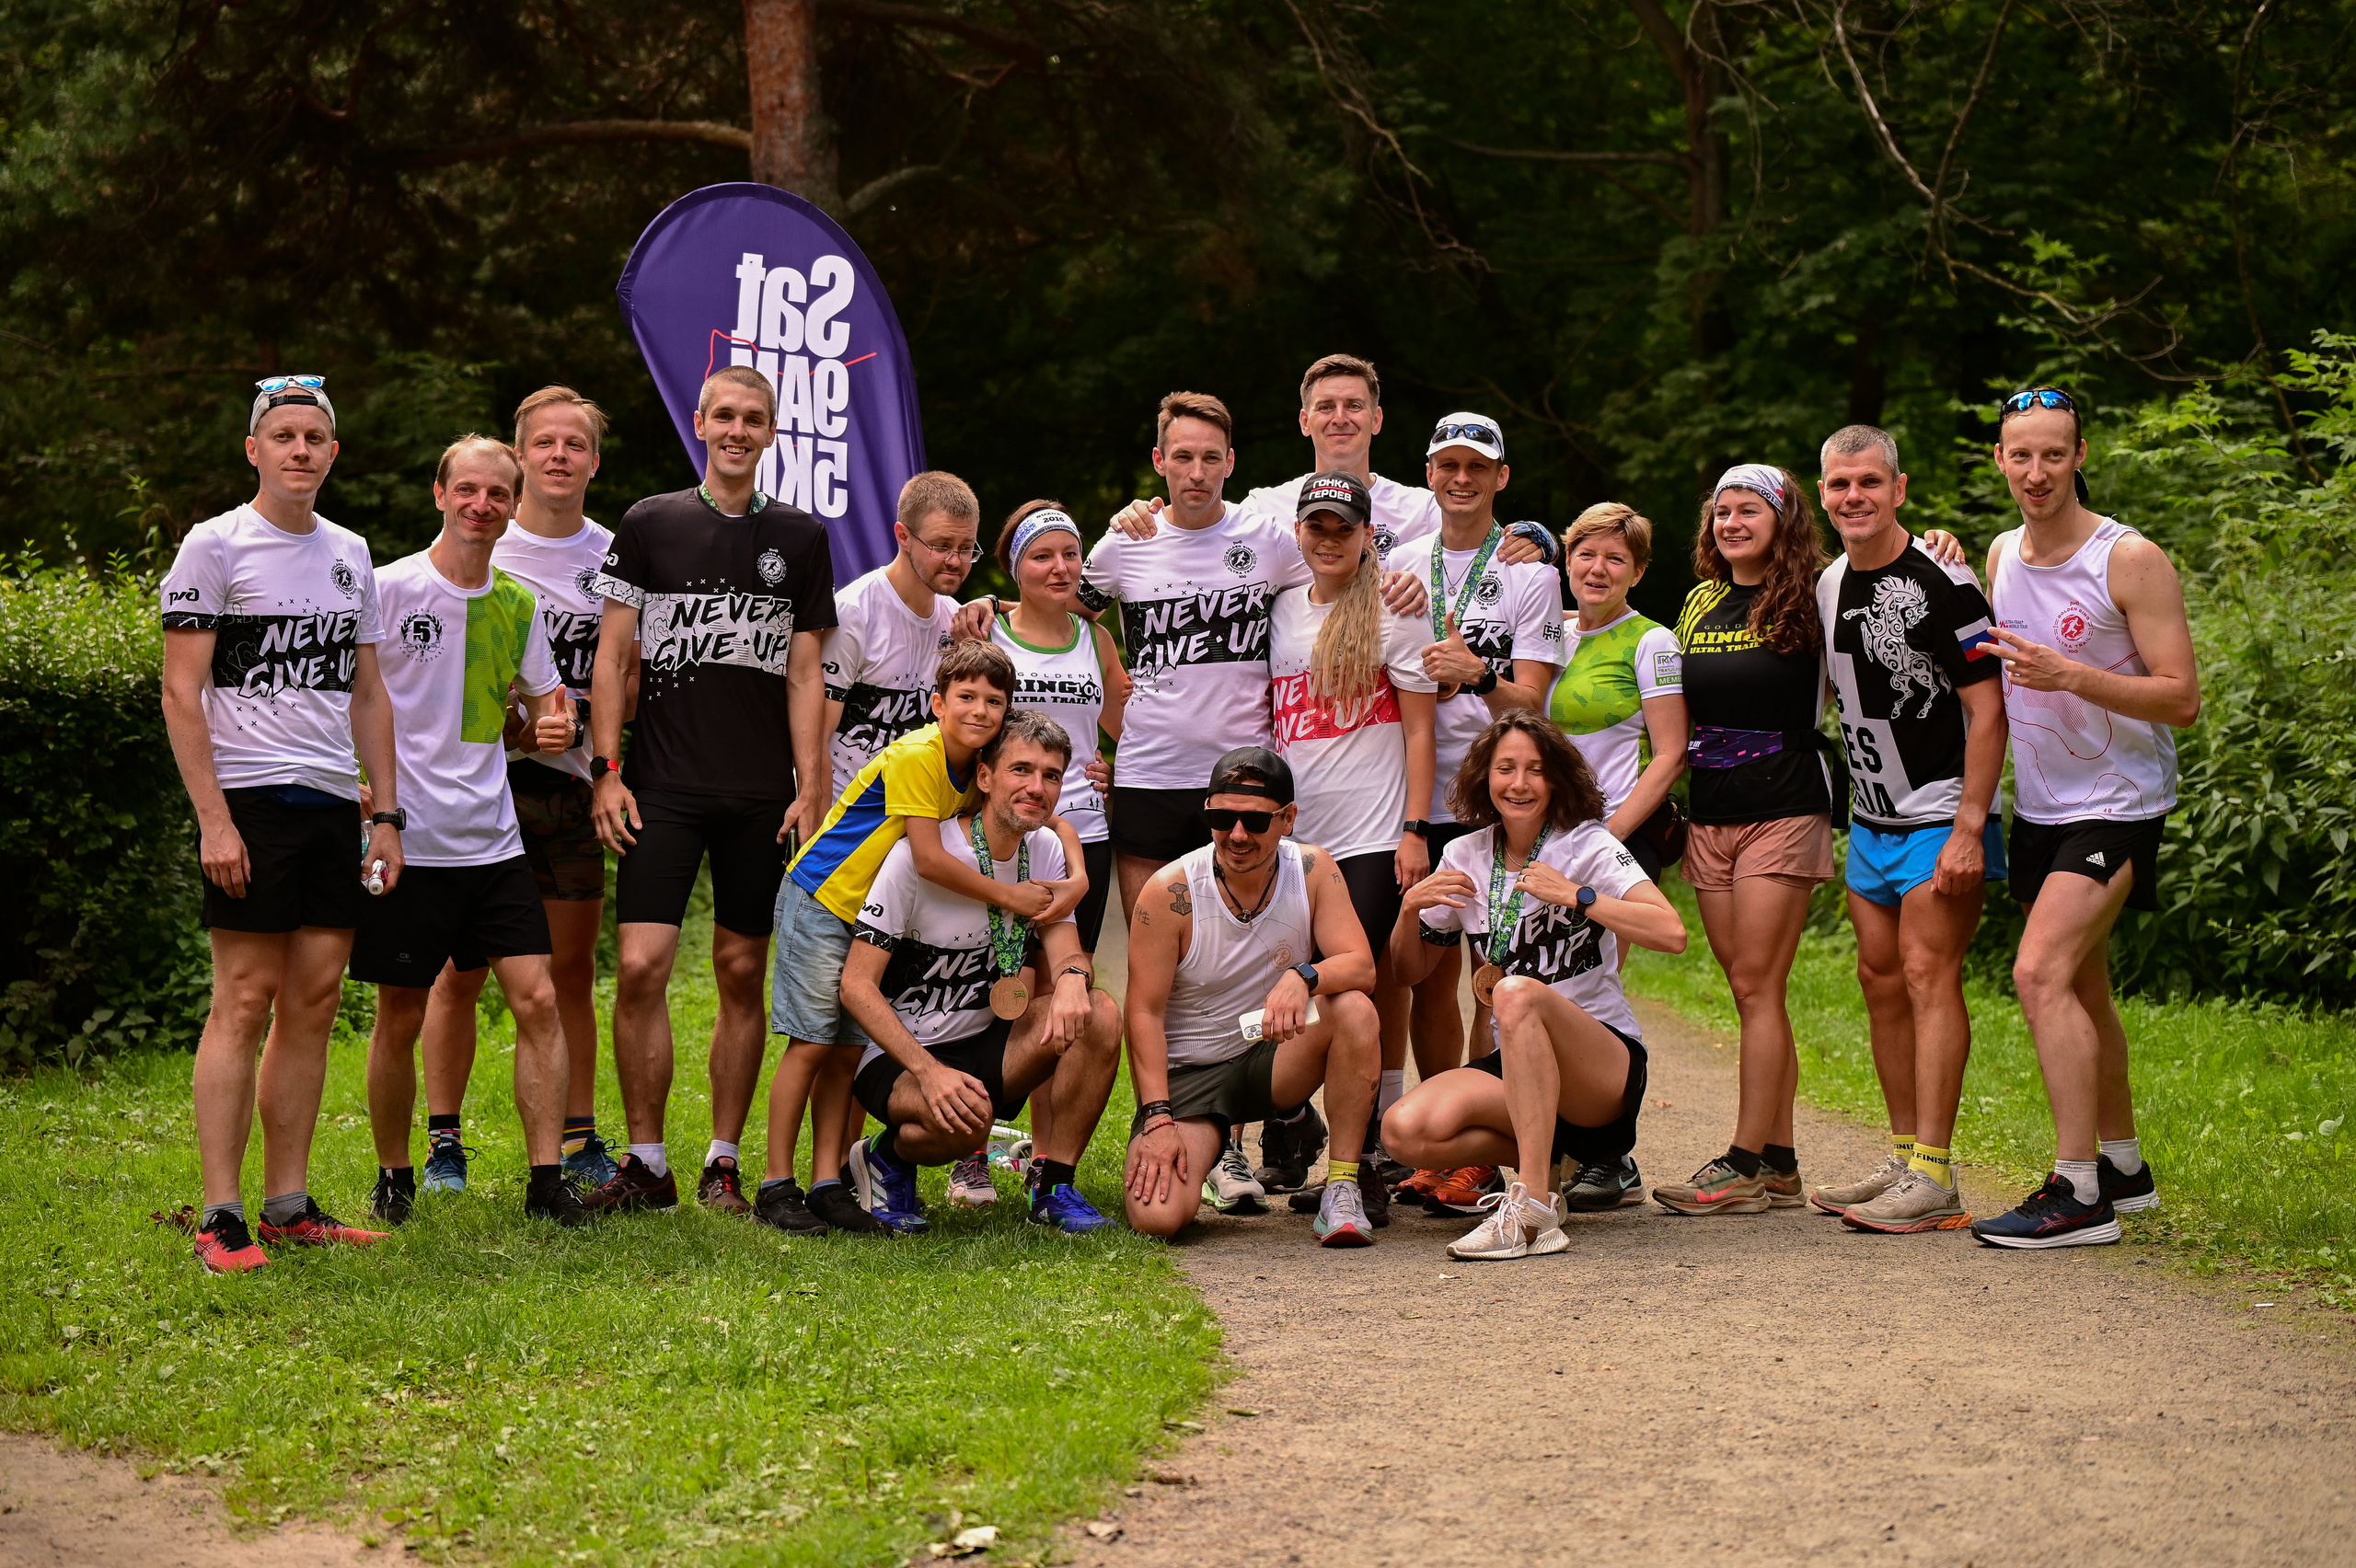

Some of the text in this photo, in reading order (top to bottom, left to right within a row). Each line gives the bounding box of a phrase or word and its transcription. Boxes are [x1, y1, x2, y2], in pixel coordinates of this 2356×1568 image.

[1312, 478, 1350, 490] ГОНКА
[1308, 489, 1352, 502] ГЕРОЕВ
[668, 592, 792, 632] NEVER
[1143, 581, 1269, 640] NEVER
[412, 620, 432, 644] 5
[1691, 629, 1753, 645] RING
[1690, 641, 1761, 654] ULTRA TRAIL
[1658, 675, 1682, 686] MEMB
[1050, 696, 1089, 706] TRAIL
